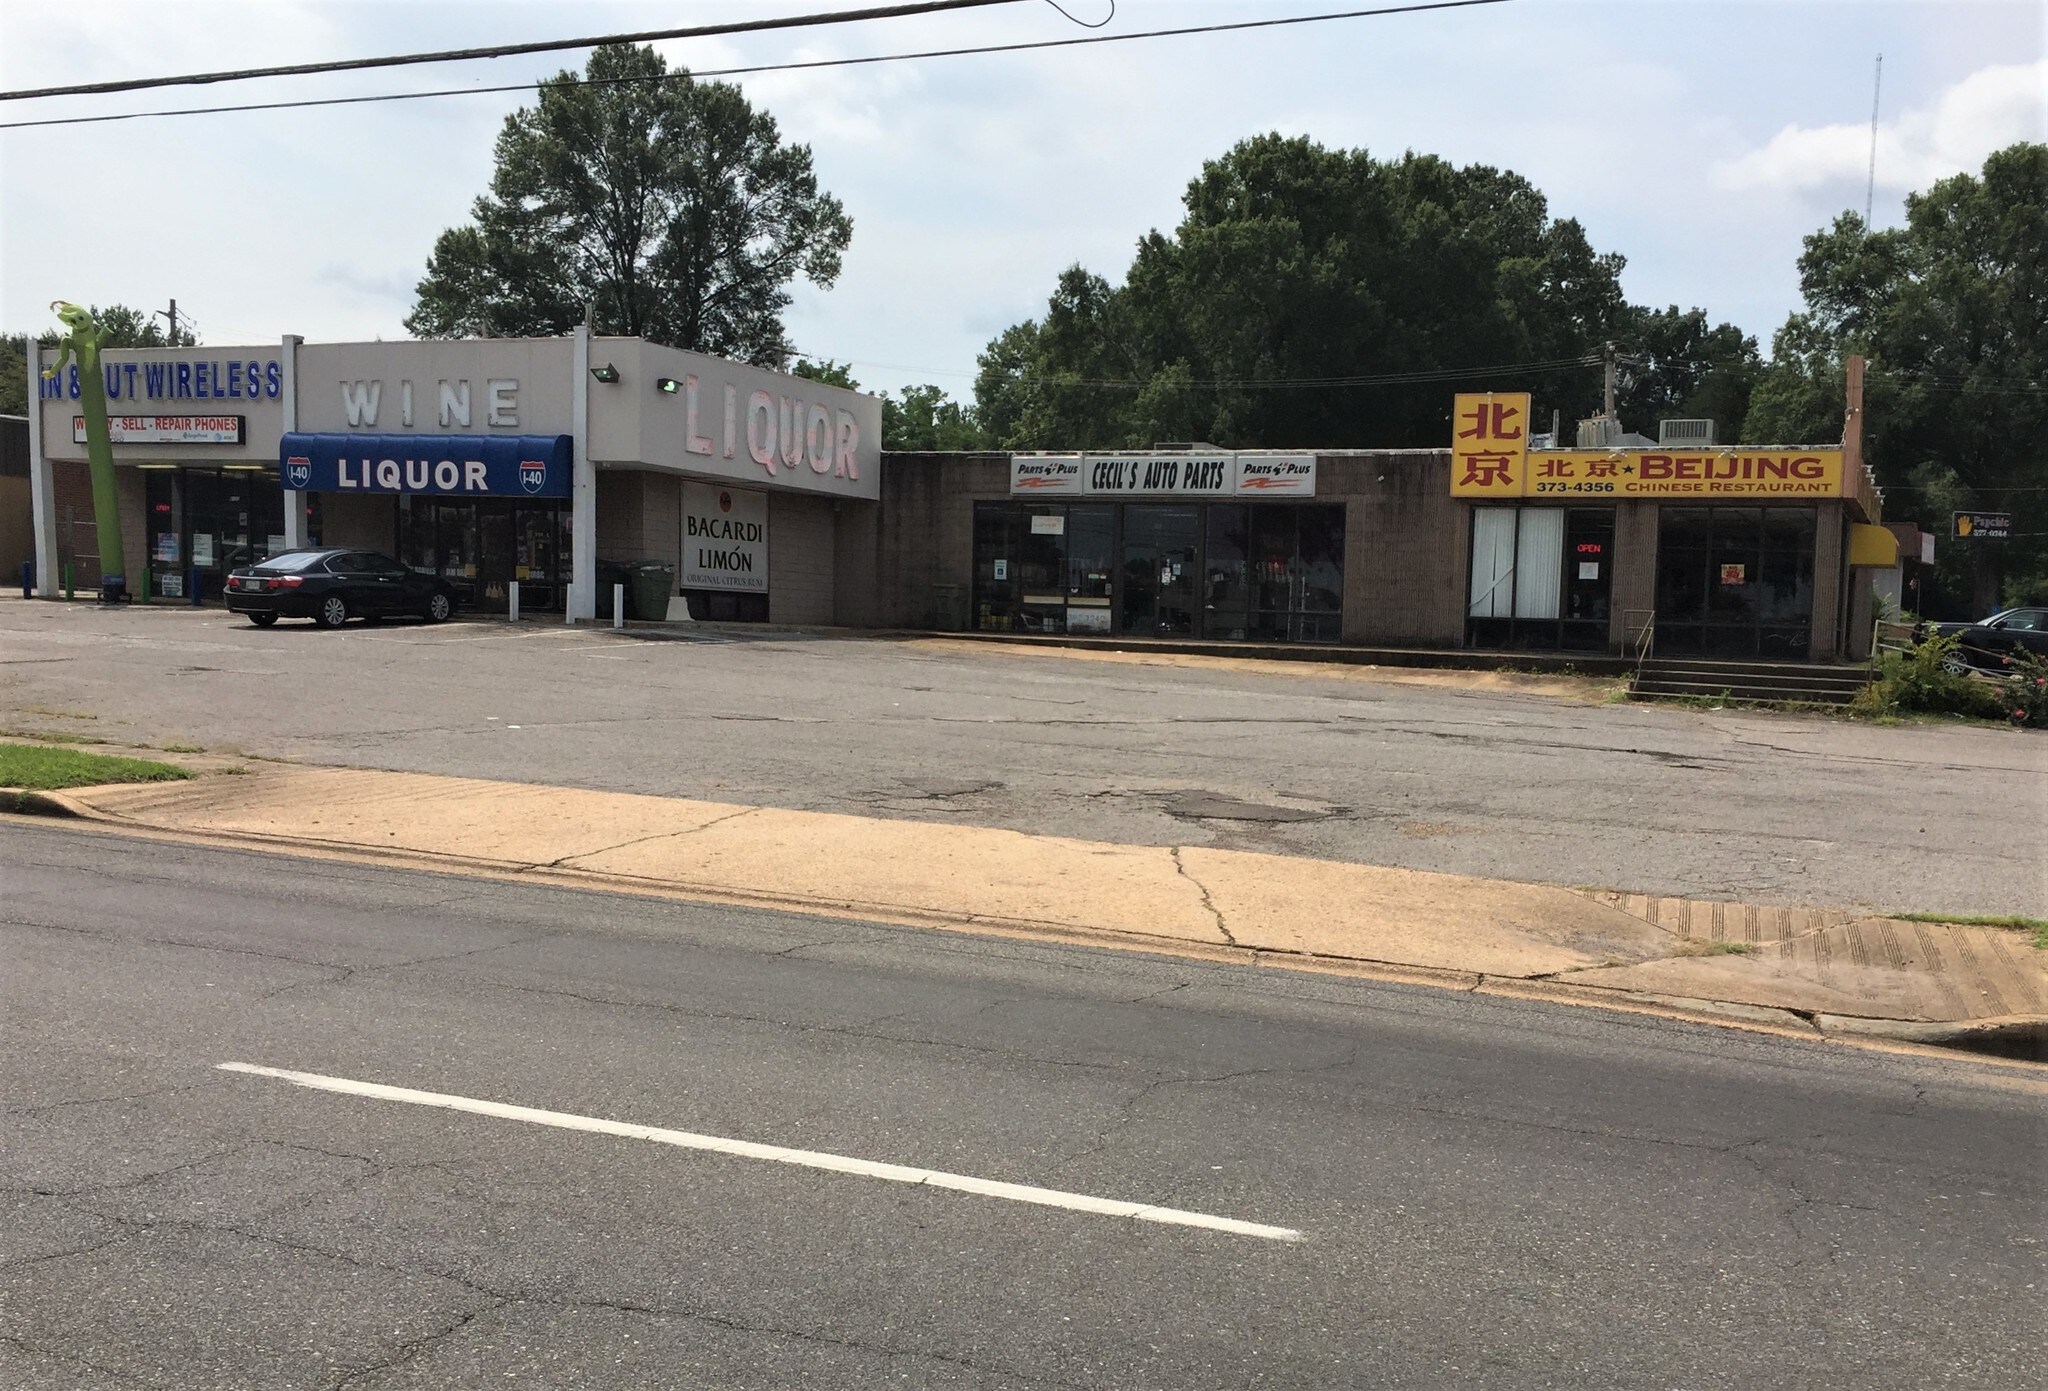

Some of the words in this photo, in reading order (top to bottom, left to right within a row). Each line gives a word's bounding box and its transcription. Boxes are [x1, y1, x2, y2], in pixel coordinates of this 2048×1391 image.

[105, 363, 138, 399] UT
[145, 361, 280, 399] WIRELESS
[339, 379, 519, 427] WINE
[122, 417, 147, 431] SELL
[155, 417, 192, 431] REPAIR
[194, 417, 237, 431] PHONES
[686, 374, 859, 480] LIQUOR
[1458, 403, 1521, 487] 北京
[290, 466, 308, 480] I-40
[338, 459, 489, 490] LIQUOR
[1092, 462, 1137, 490] CECIL'S
[1143, 462, 1177, 490] AUTO
[1183, 462, 1224, 490] PARTS
[1536, 459, 1622, 478] 北京
[1639, 455, 1825, 479] BEIJING
[523, 472, 542, 486] I-40
[1536, 482, 1614, 493] 373-4356
[1625, 482, 1703, 492] CHINESE
[1710, 482, 1832, 492] RESTAURANT
[687, 516, 763, 543] BACARDI
[1973, 516, 2010, 528] Psychic
[699, 546, 752, 572] LIMÓN
[1577, 544, 1601, 553] OPEN
[687, 574, 720, 584] ORIGINAL
[722, 577, 745, 587] CITRUS
[747, 579, 763, 588] RUM
